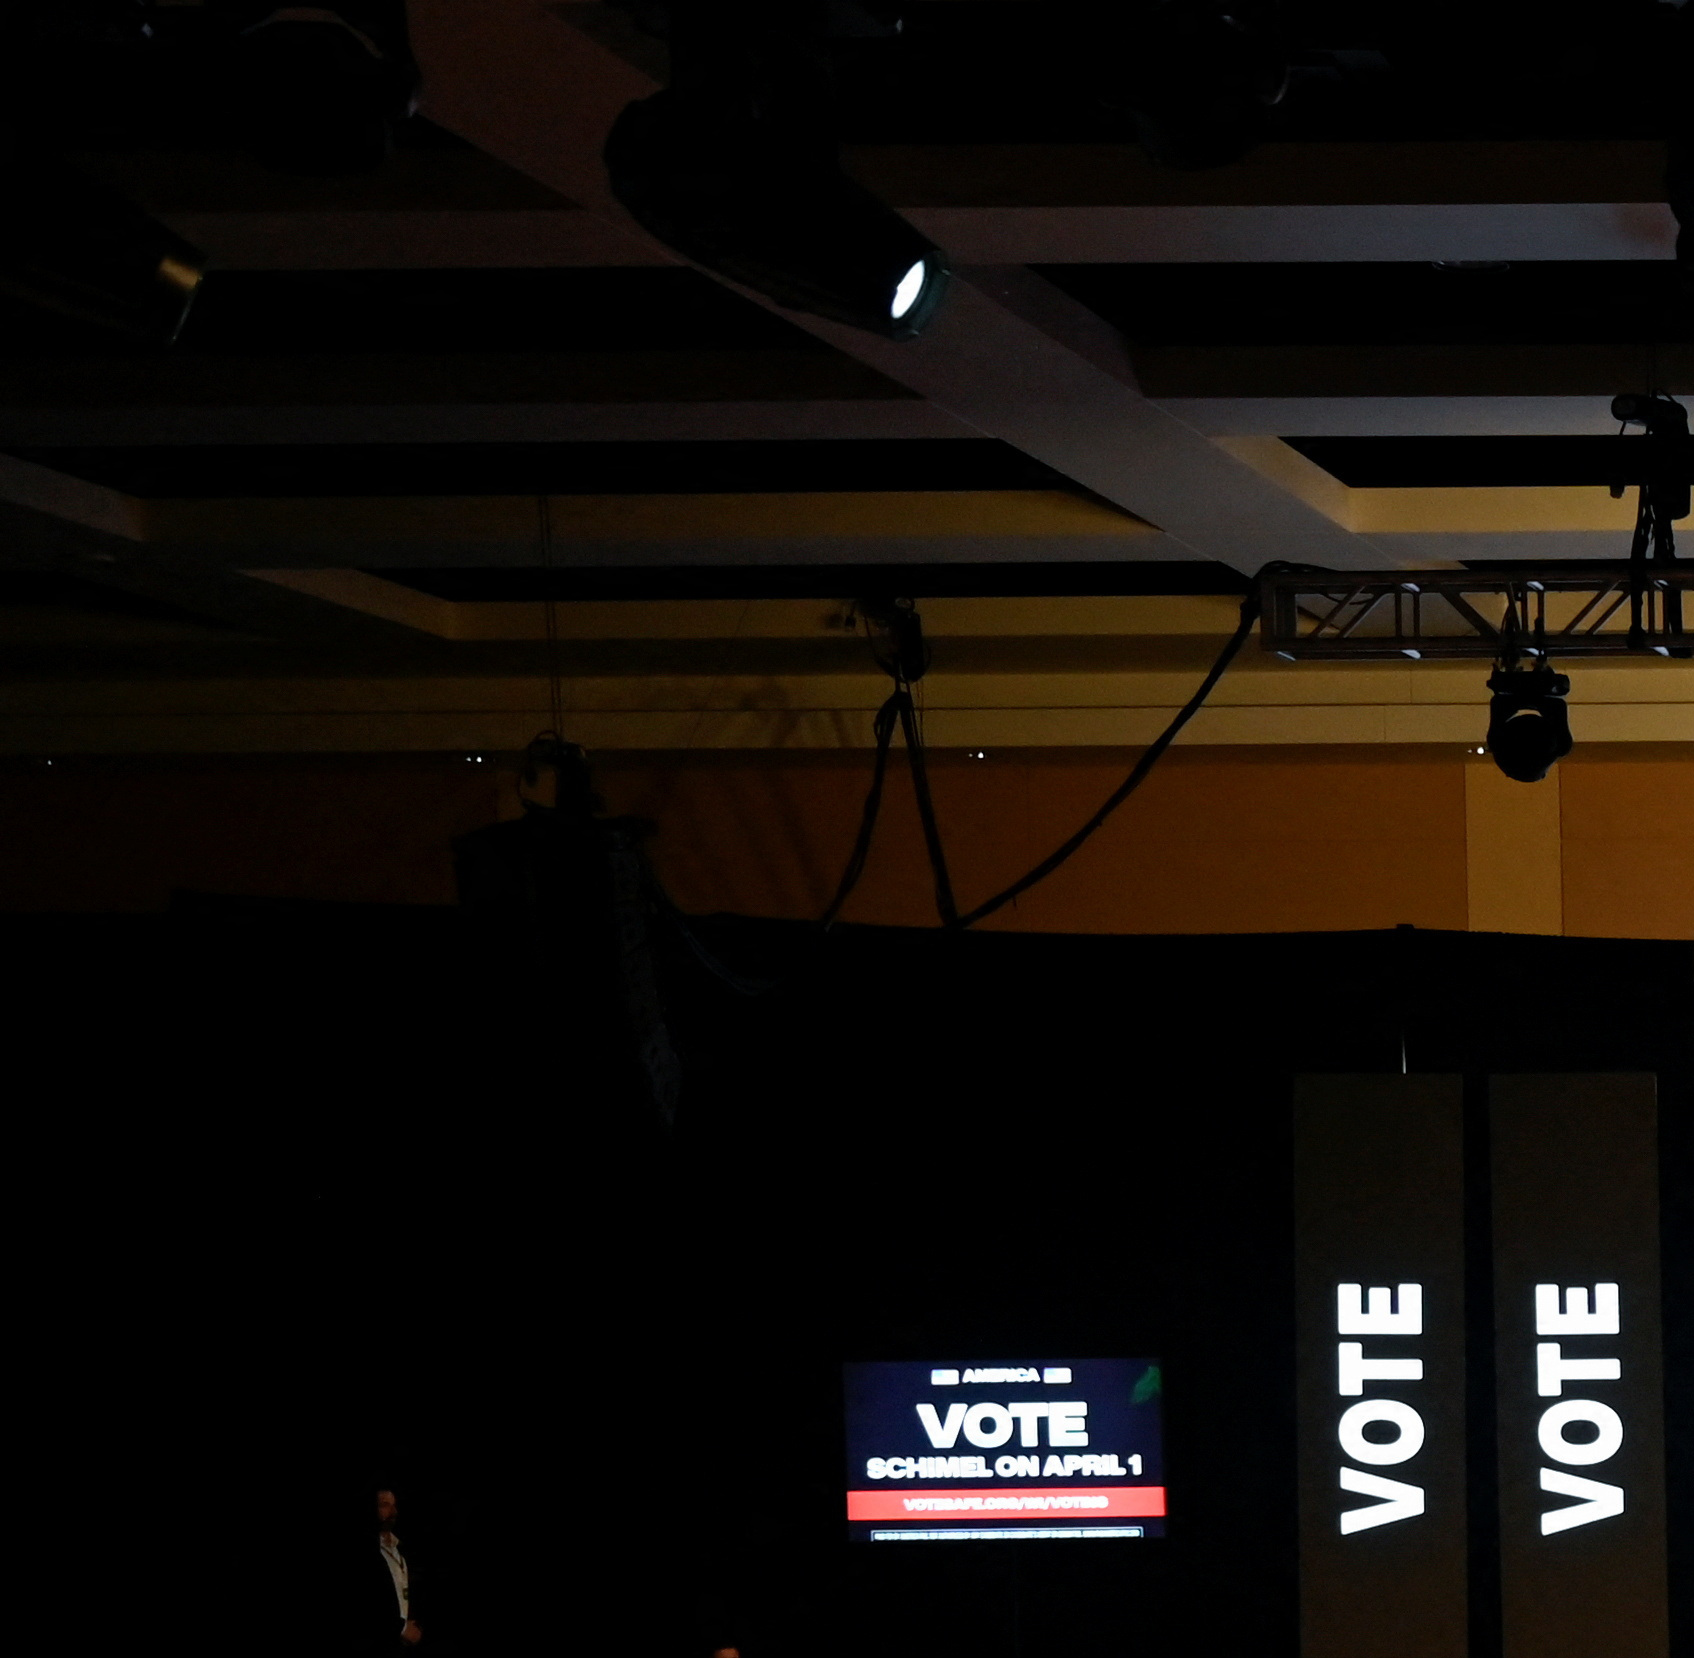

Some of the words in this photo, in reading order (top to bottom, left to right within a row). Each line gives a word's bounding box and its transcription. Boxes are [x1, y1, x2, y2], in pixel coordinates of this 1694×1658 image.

[962, 1367, 1041, 1383] AMERICA
[915, 1401, 1089, 1449] VOTE
[1337, 1283, 1425, 1536] VOTE
[1535, 1283, 1625, 1536] VOTE
[866, 1456, 993, 1479] SCHIMEL
[994, 1456, 1041, 1477] ON
[1042, 1454, 1126, 1477] APRIL
[1127, 1454, 1143, 1476] 1
